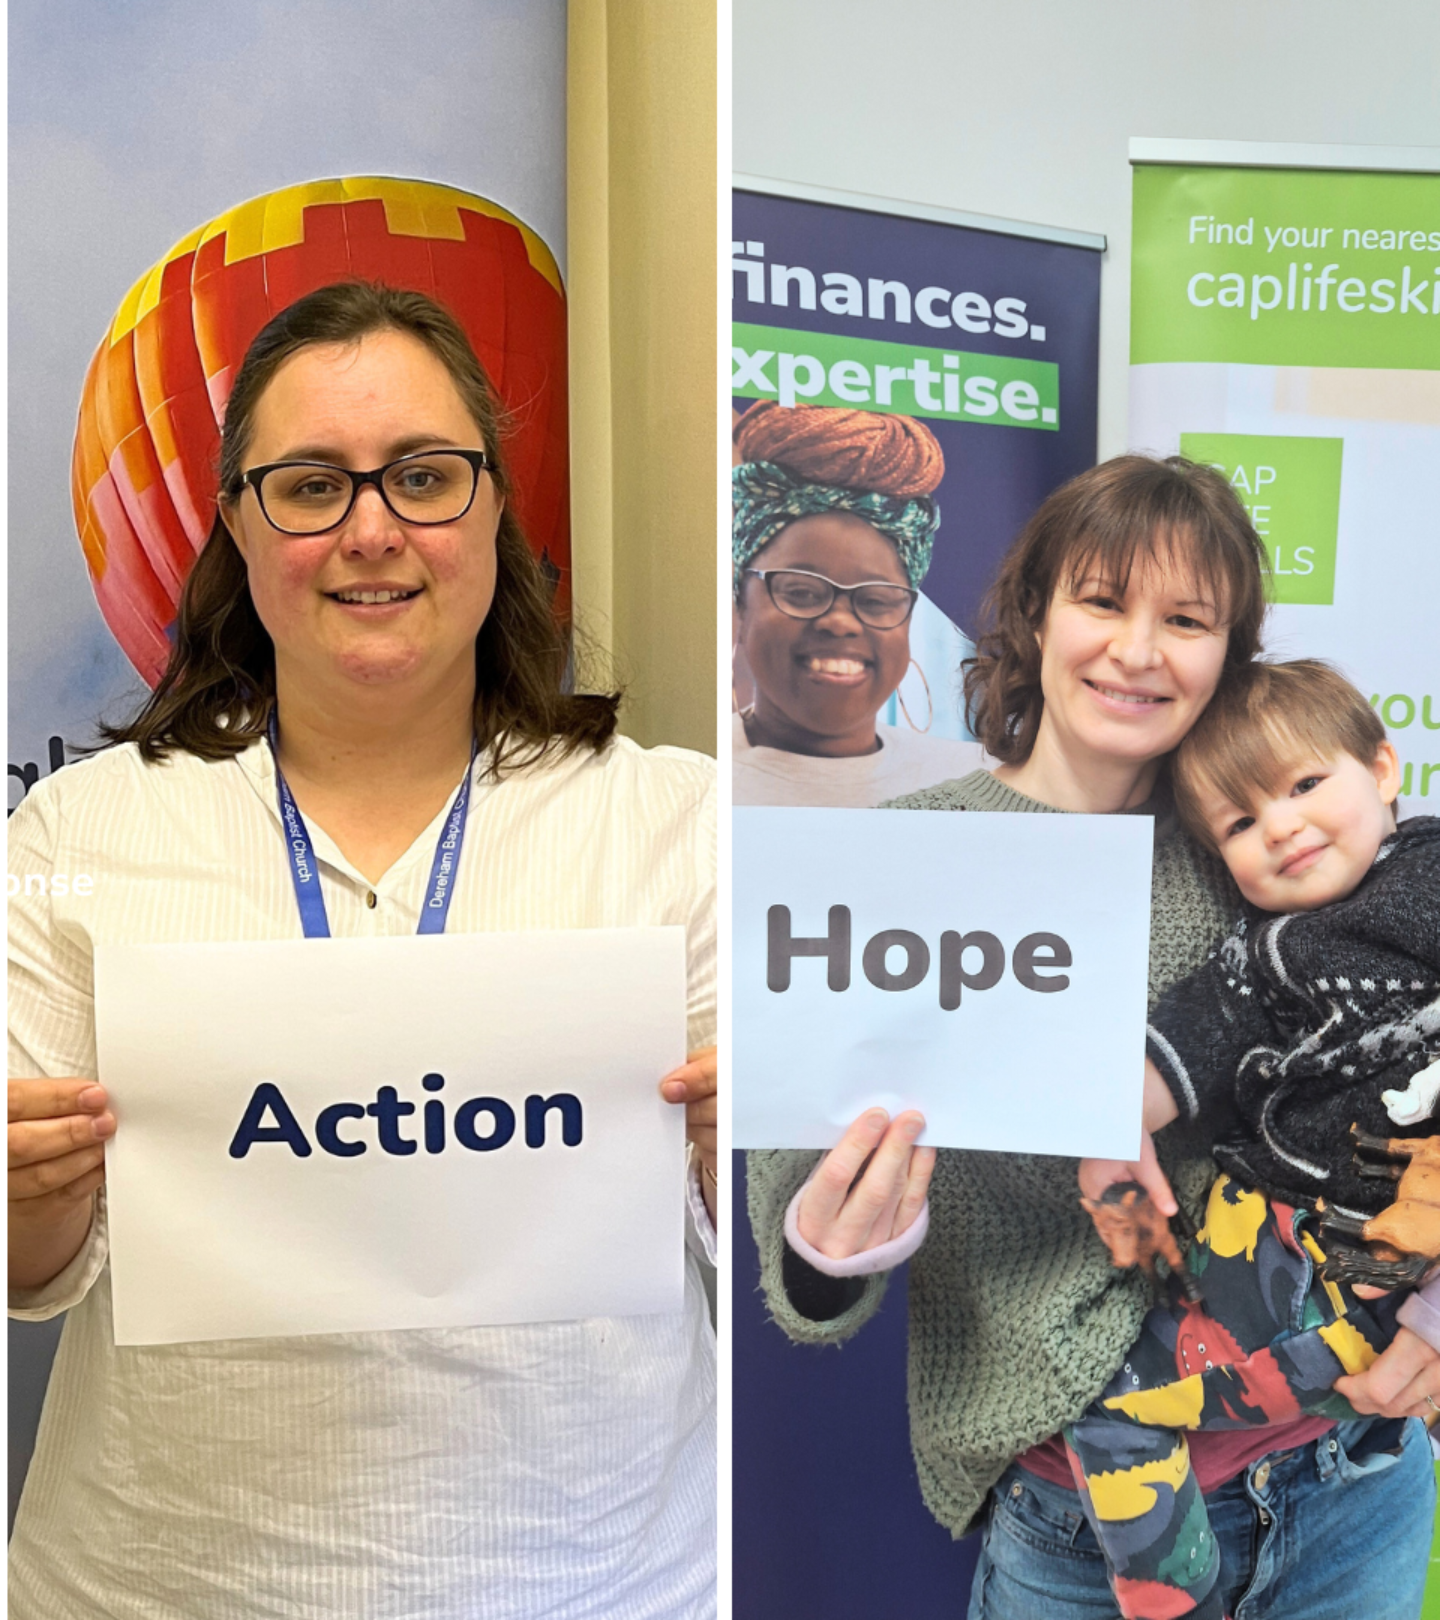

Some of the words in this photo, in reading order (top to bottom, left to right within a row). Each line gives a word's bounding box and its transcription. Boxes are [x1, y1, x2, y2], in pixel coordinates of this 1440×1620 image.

[1188, 215, 1254, 246] Find
[1263, 226, 1334, 253] your
[1342, 228, 1440, 252] neares
[1186, 262, 1440, 320] caplifeski
[1210, 463, 1277, 495] AP
[1369, 693, 1440, 730] ou
[292, 839, 313, 883] Church
[429, 851, 454, 908] Dereham
[766, 904, 1074, 1012] Hope
[228, 1073, 584, 1159] Action
